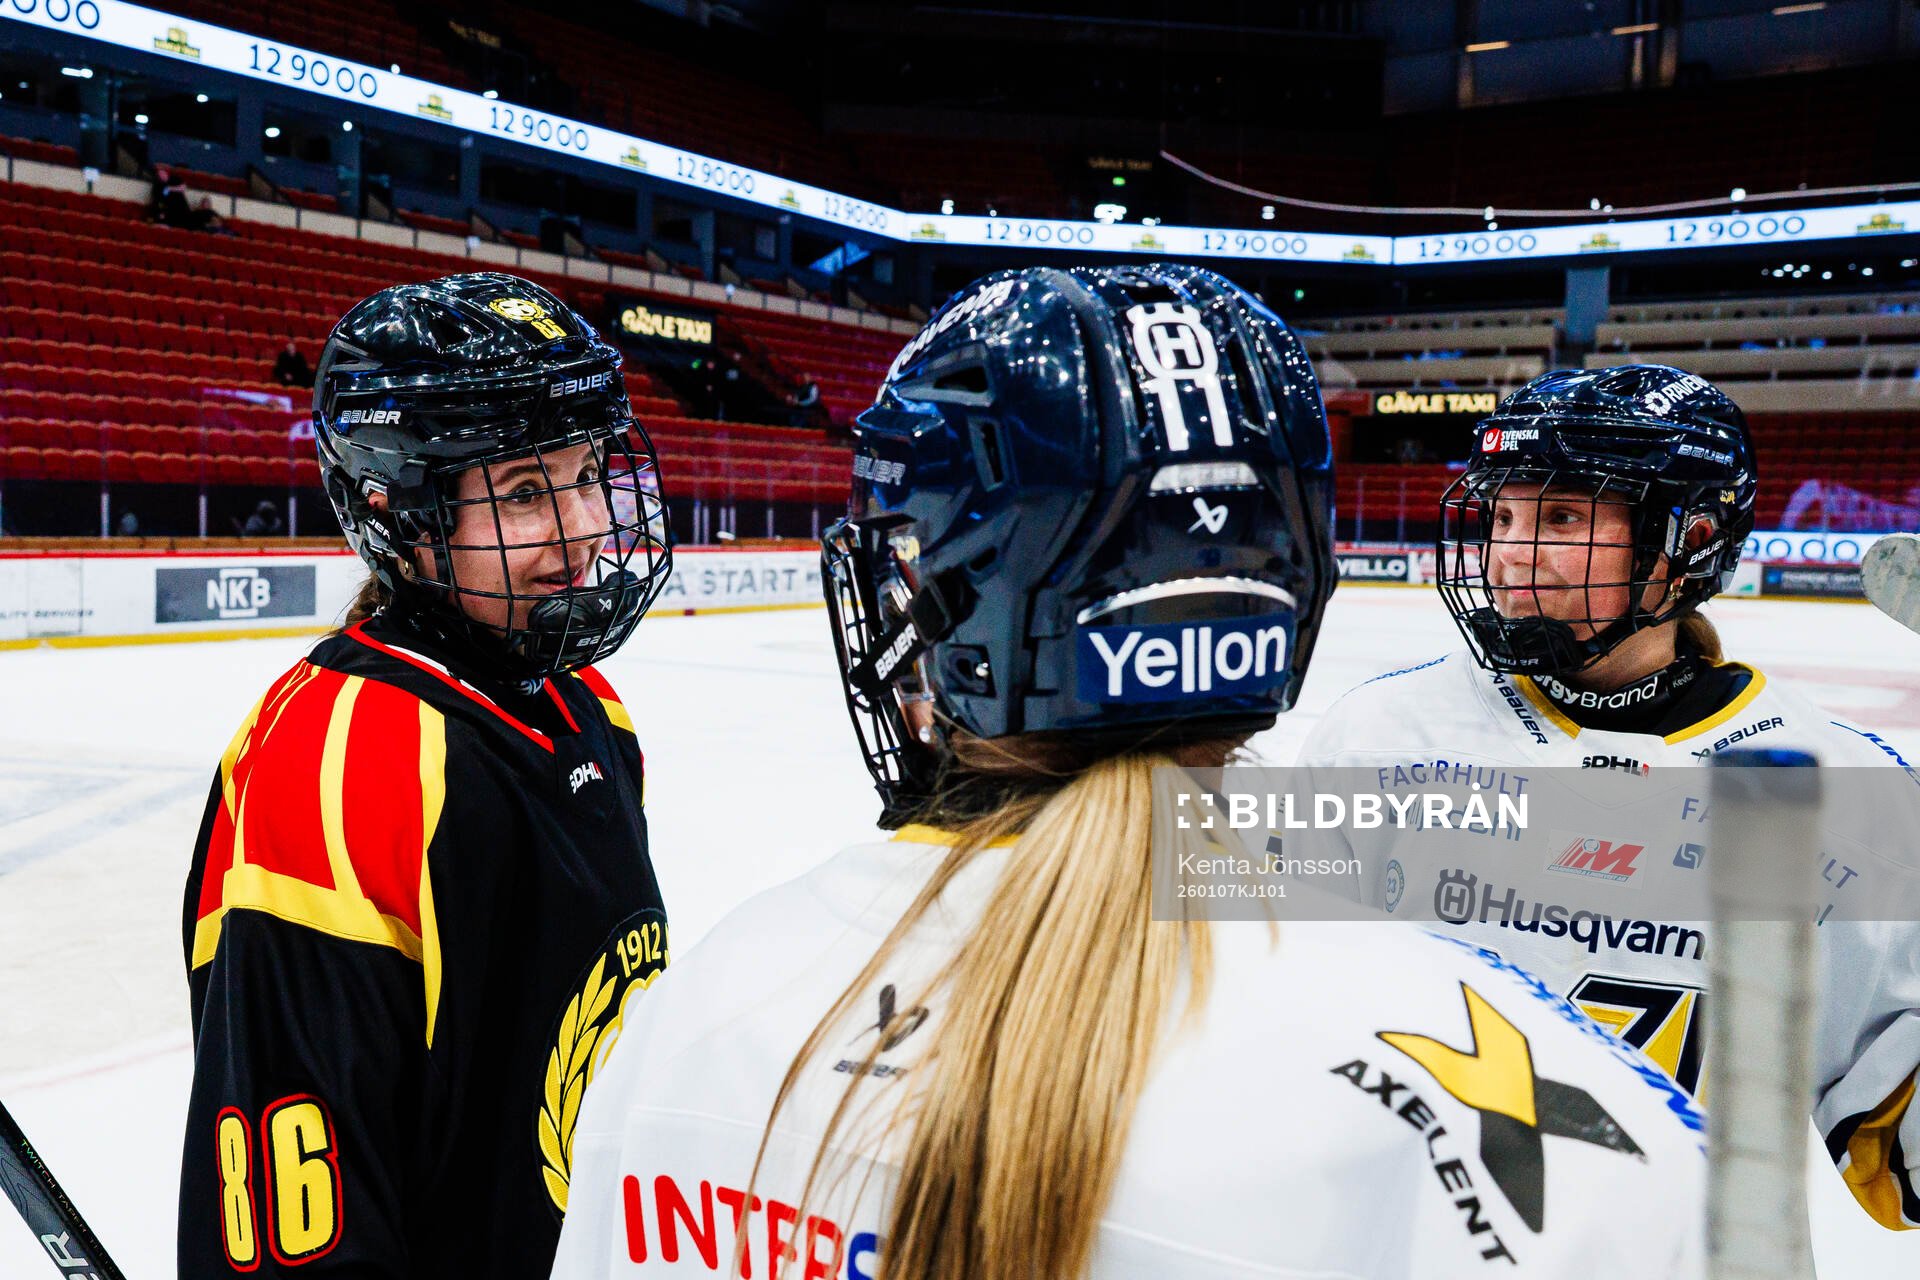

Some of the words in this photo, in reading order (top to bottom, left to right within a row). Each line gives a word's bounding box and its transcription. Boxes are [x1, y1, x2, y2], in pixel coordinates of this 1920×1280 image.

[549, 370, 613, 399] BAUER
[341, 409, 401, 425] BAUER
[1449, 394, 1496, 413] TAXI
[1500, 429, 1539, 441] SVENSKA
[1500, 441, 1519, 451] SPEL
[1678, 444, 1734, 467] BAUER
[207, 577, 271, 611] NKB
[702, 568, 799, 596] START
[875, 622, 918, 681] BAUER
[1089, 625, 1287, 697] Yellon
[1498, 686, 1549, 745] BAUER
[1714, 716, 1785, 751] BAUER
[1479, 883, 1706, 961] Husqvarn
[616, 921, 662, 978] 1912
[1330, 1059, 1517, 1265] AXELENT
[216, 1093, 343, 1273] 86
